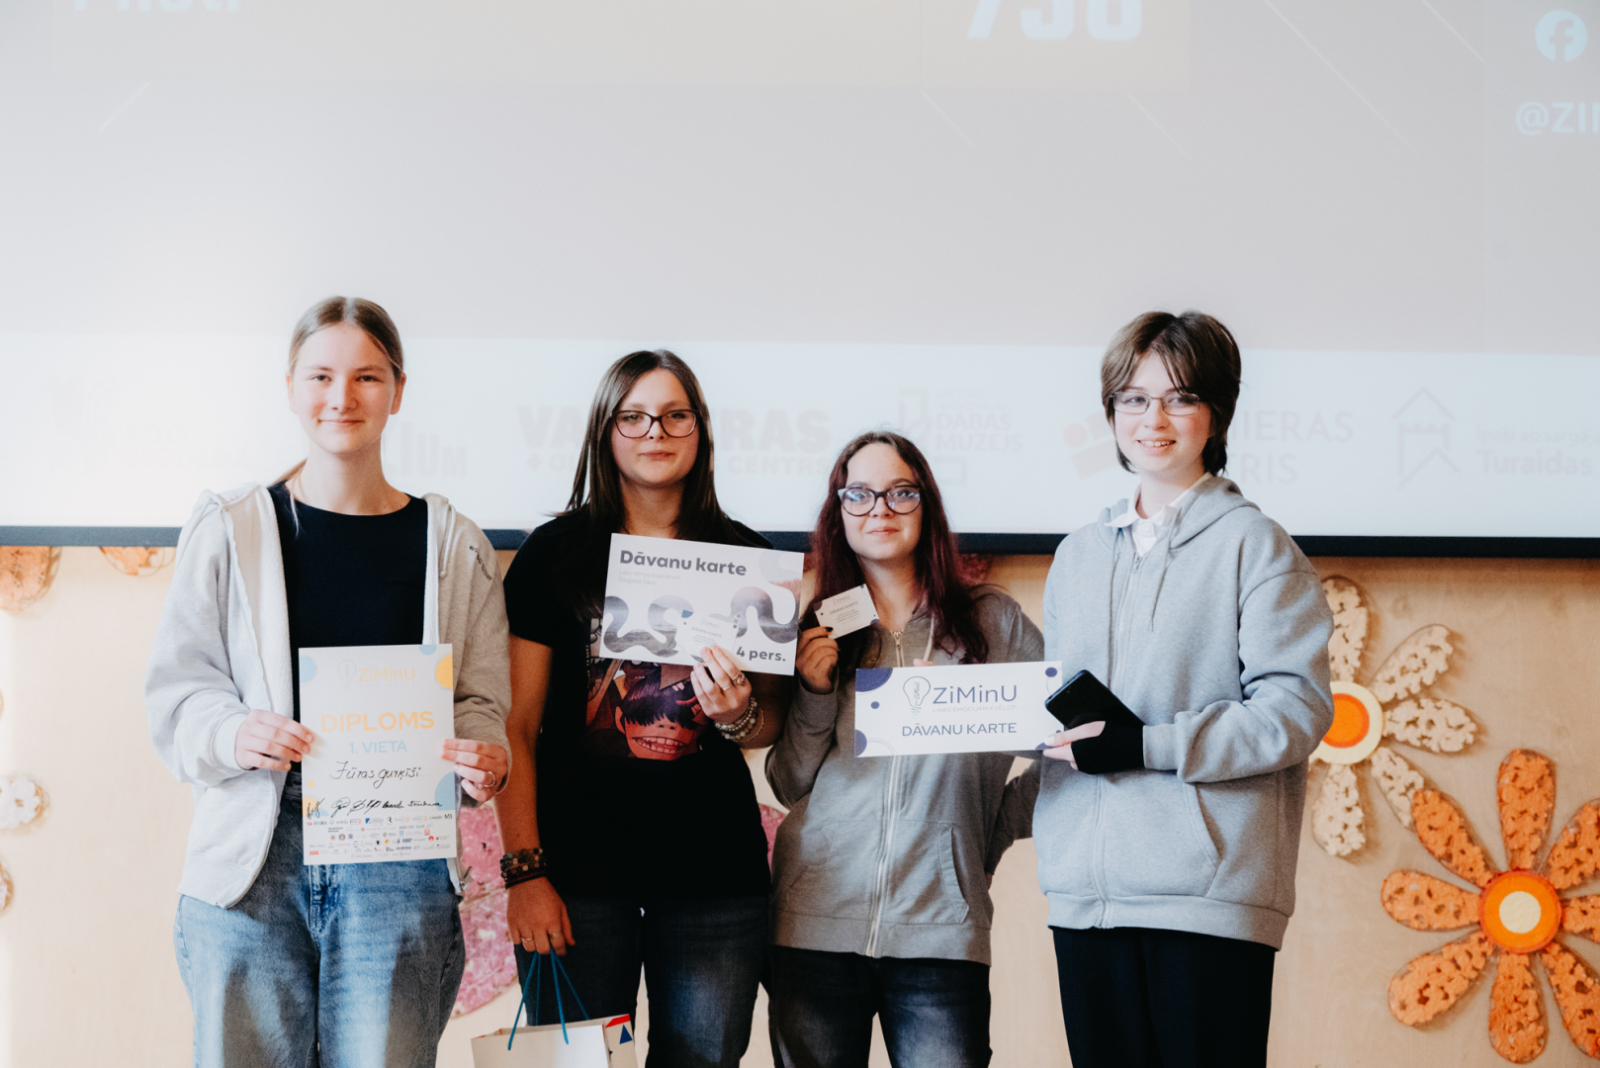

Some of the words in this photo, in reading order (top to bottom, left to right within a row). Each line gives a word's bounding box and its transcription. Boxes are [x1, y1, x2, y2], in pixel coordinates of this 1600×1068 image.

[1476, 448, 1593, 476] Turaidas
[619, 550, 692, 571] Dāvanu
[695, 557, 747, 576] karte
[735, 646, 746, 657] 4
[748, 647, 787, 662] pers.
[358, 666, 416, 683] ZiMinU
[932, 684, 1018, 705] ZiMinU
[320, 711, 435, 733] DIPLOMS
[901, 723, 963, 737] DĀVANU
[966, 723, 1018, 735] KARTE
[349, 742, 359, 754] 1.
[362, 740, 408, 754] VIETA
